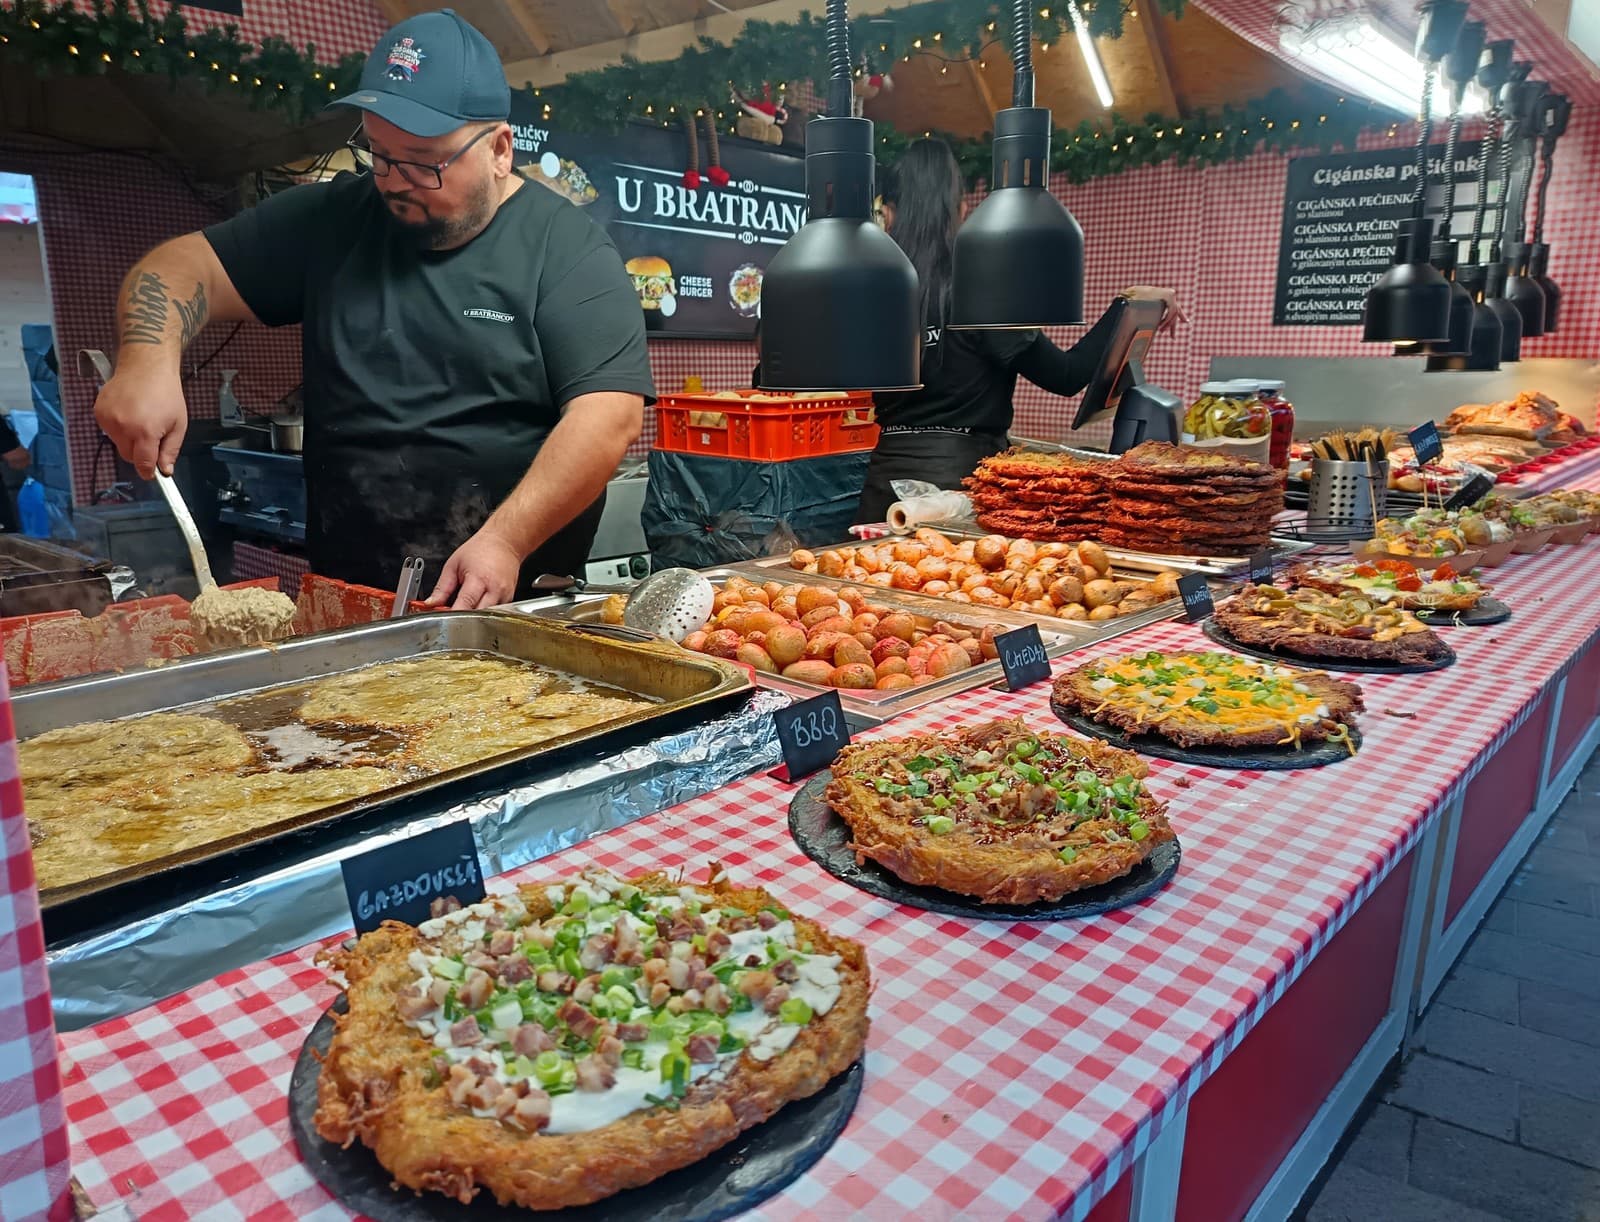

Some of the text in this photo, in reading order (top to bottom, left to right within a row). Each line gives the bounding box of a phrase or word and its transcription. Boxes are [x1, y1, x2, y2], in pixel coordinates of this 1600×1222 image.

[1313, 164, 1396, 186] Cigánska
[615, 176, 644, 213] U
[1296, 197, 1356, 211] CIGÁNSKA
[1294, 222, 1353, 235] CIGÁNSKA
[1291, 247, 1350, 260] CIGÁNSKA
[680, 275, 713, 288] CHEESE
[1289, 273, 1347, 286] CIGÁNSKA
[680, 286, 713, 298] BURGER
[1286, 299, 1343, 312] CIGÁNSKA
[790, 706, 839, 748] BBQ
